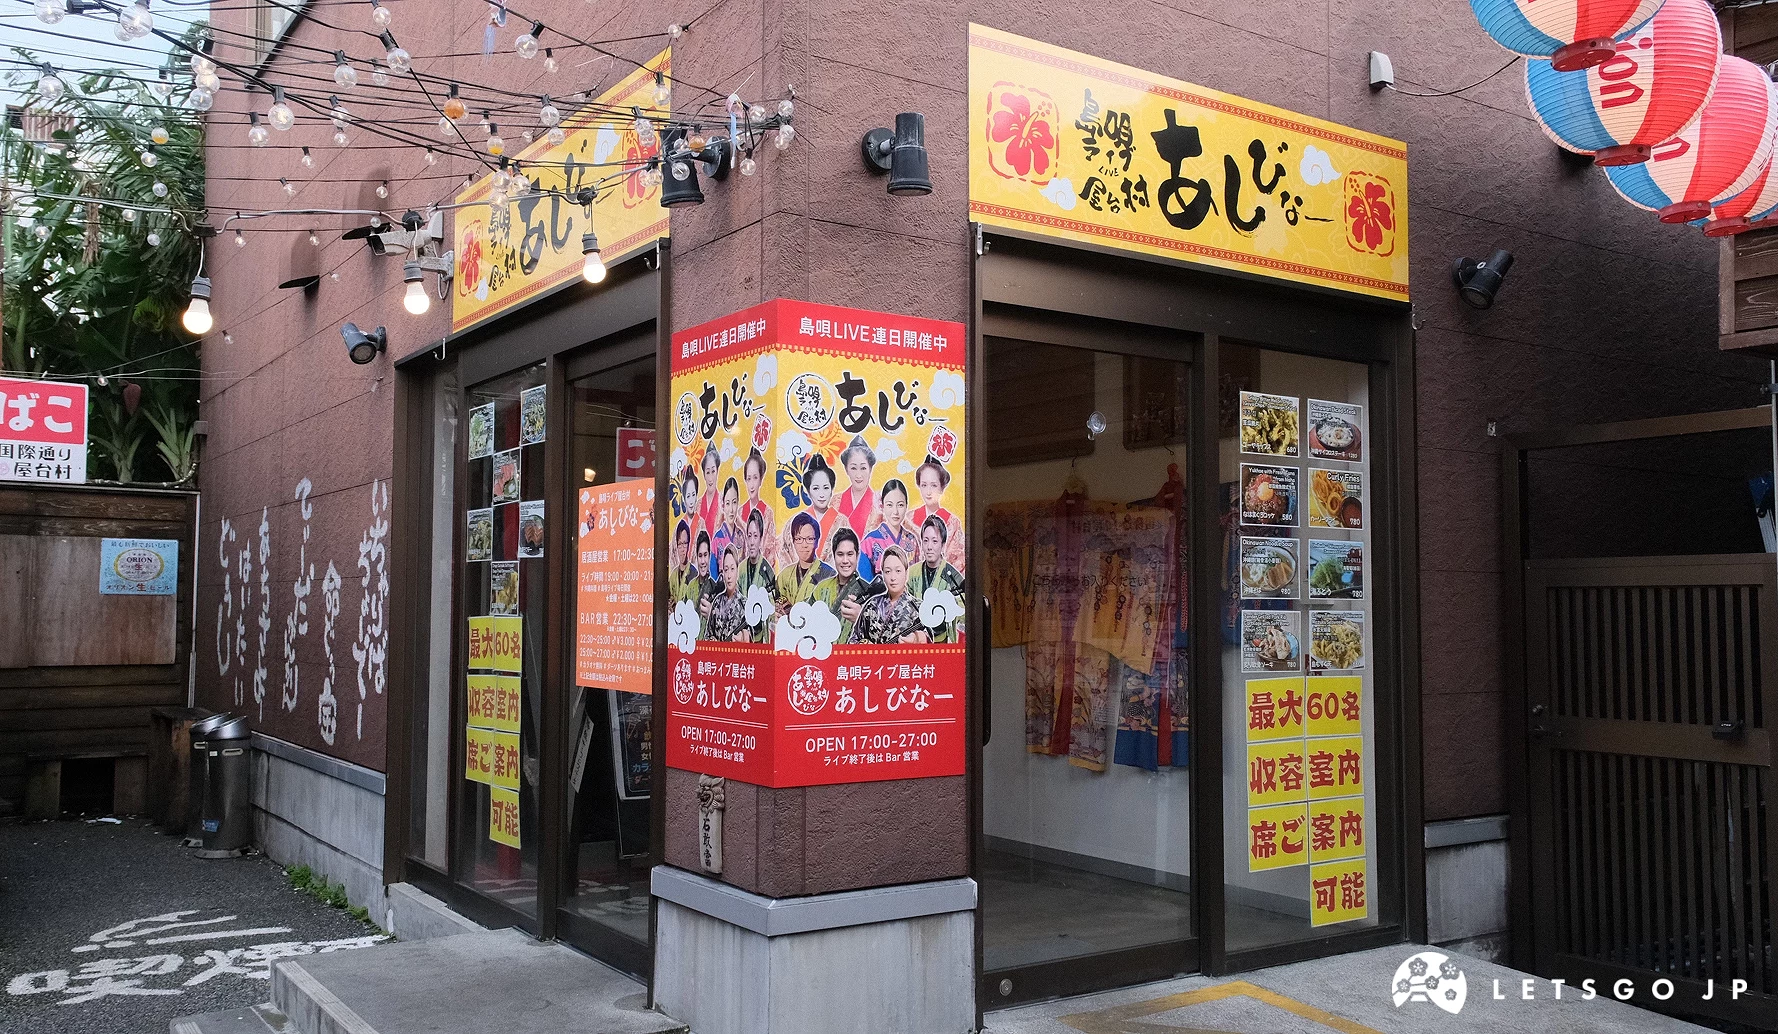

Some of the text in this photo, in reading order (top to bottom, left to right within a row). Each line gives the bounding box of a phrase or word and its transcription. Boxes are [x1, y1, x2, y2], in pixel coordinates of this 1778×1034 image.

[1098, 166, 1119, 177] LIVE
[1150, 108, 1334, 238] あしびなー
[1078, 176, 1150, 214] 屋台村
[699, 373, 766, 440] あしびなー
[834, 371, 948, 435] あしびなー
[0, 444, 71, 461] 国際通り
[14, 461, 72, 479] 屋台村
[1326, 472, 1360, 483] Curly Fries
[598, 504, 650, 530] あしびなー
[234, 538, 252, 707] はいたい
[697, 660, 755, 680] 島唄ライブ屋台村
[836, 664, 936, 681] 島唄ライブ屋台村
[696, 680, 767, 713] あしびなー
[835, 683, 954, 714] あしびなー
[681, 725, 756, 750] OPEN 17:00-27:00
[805, 731, 937, 753] OPEN 17:00-27:00
[723, 750, 733, 760] Bar
[823, 750, 920, 767] ライブ終了後は Bar 営業
[492, 799, 519, 838] 可能
[1312, 871, 1365, 913] 可能
